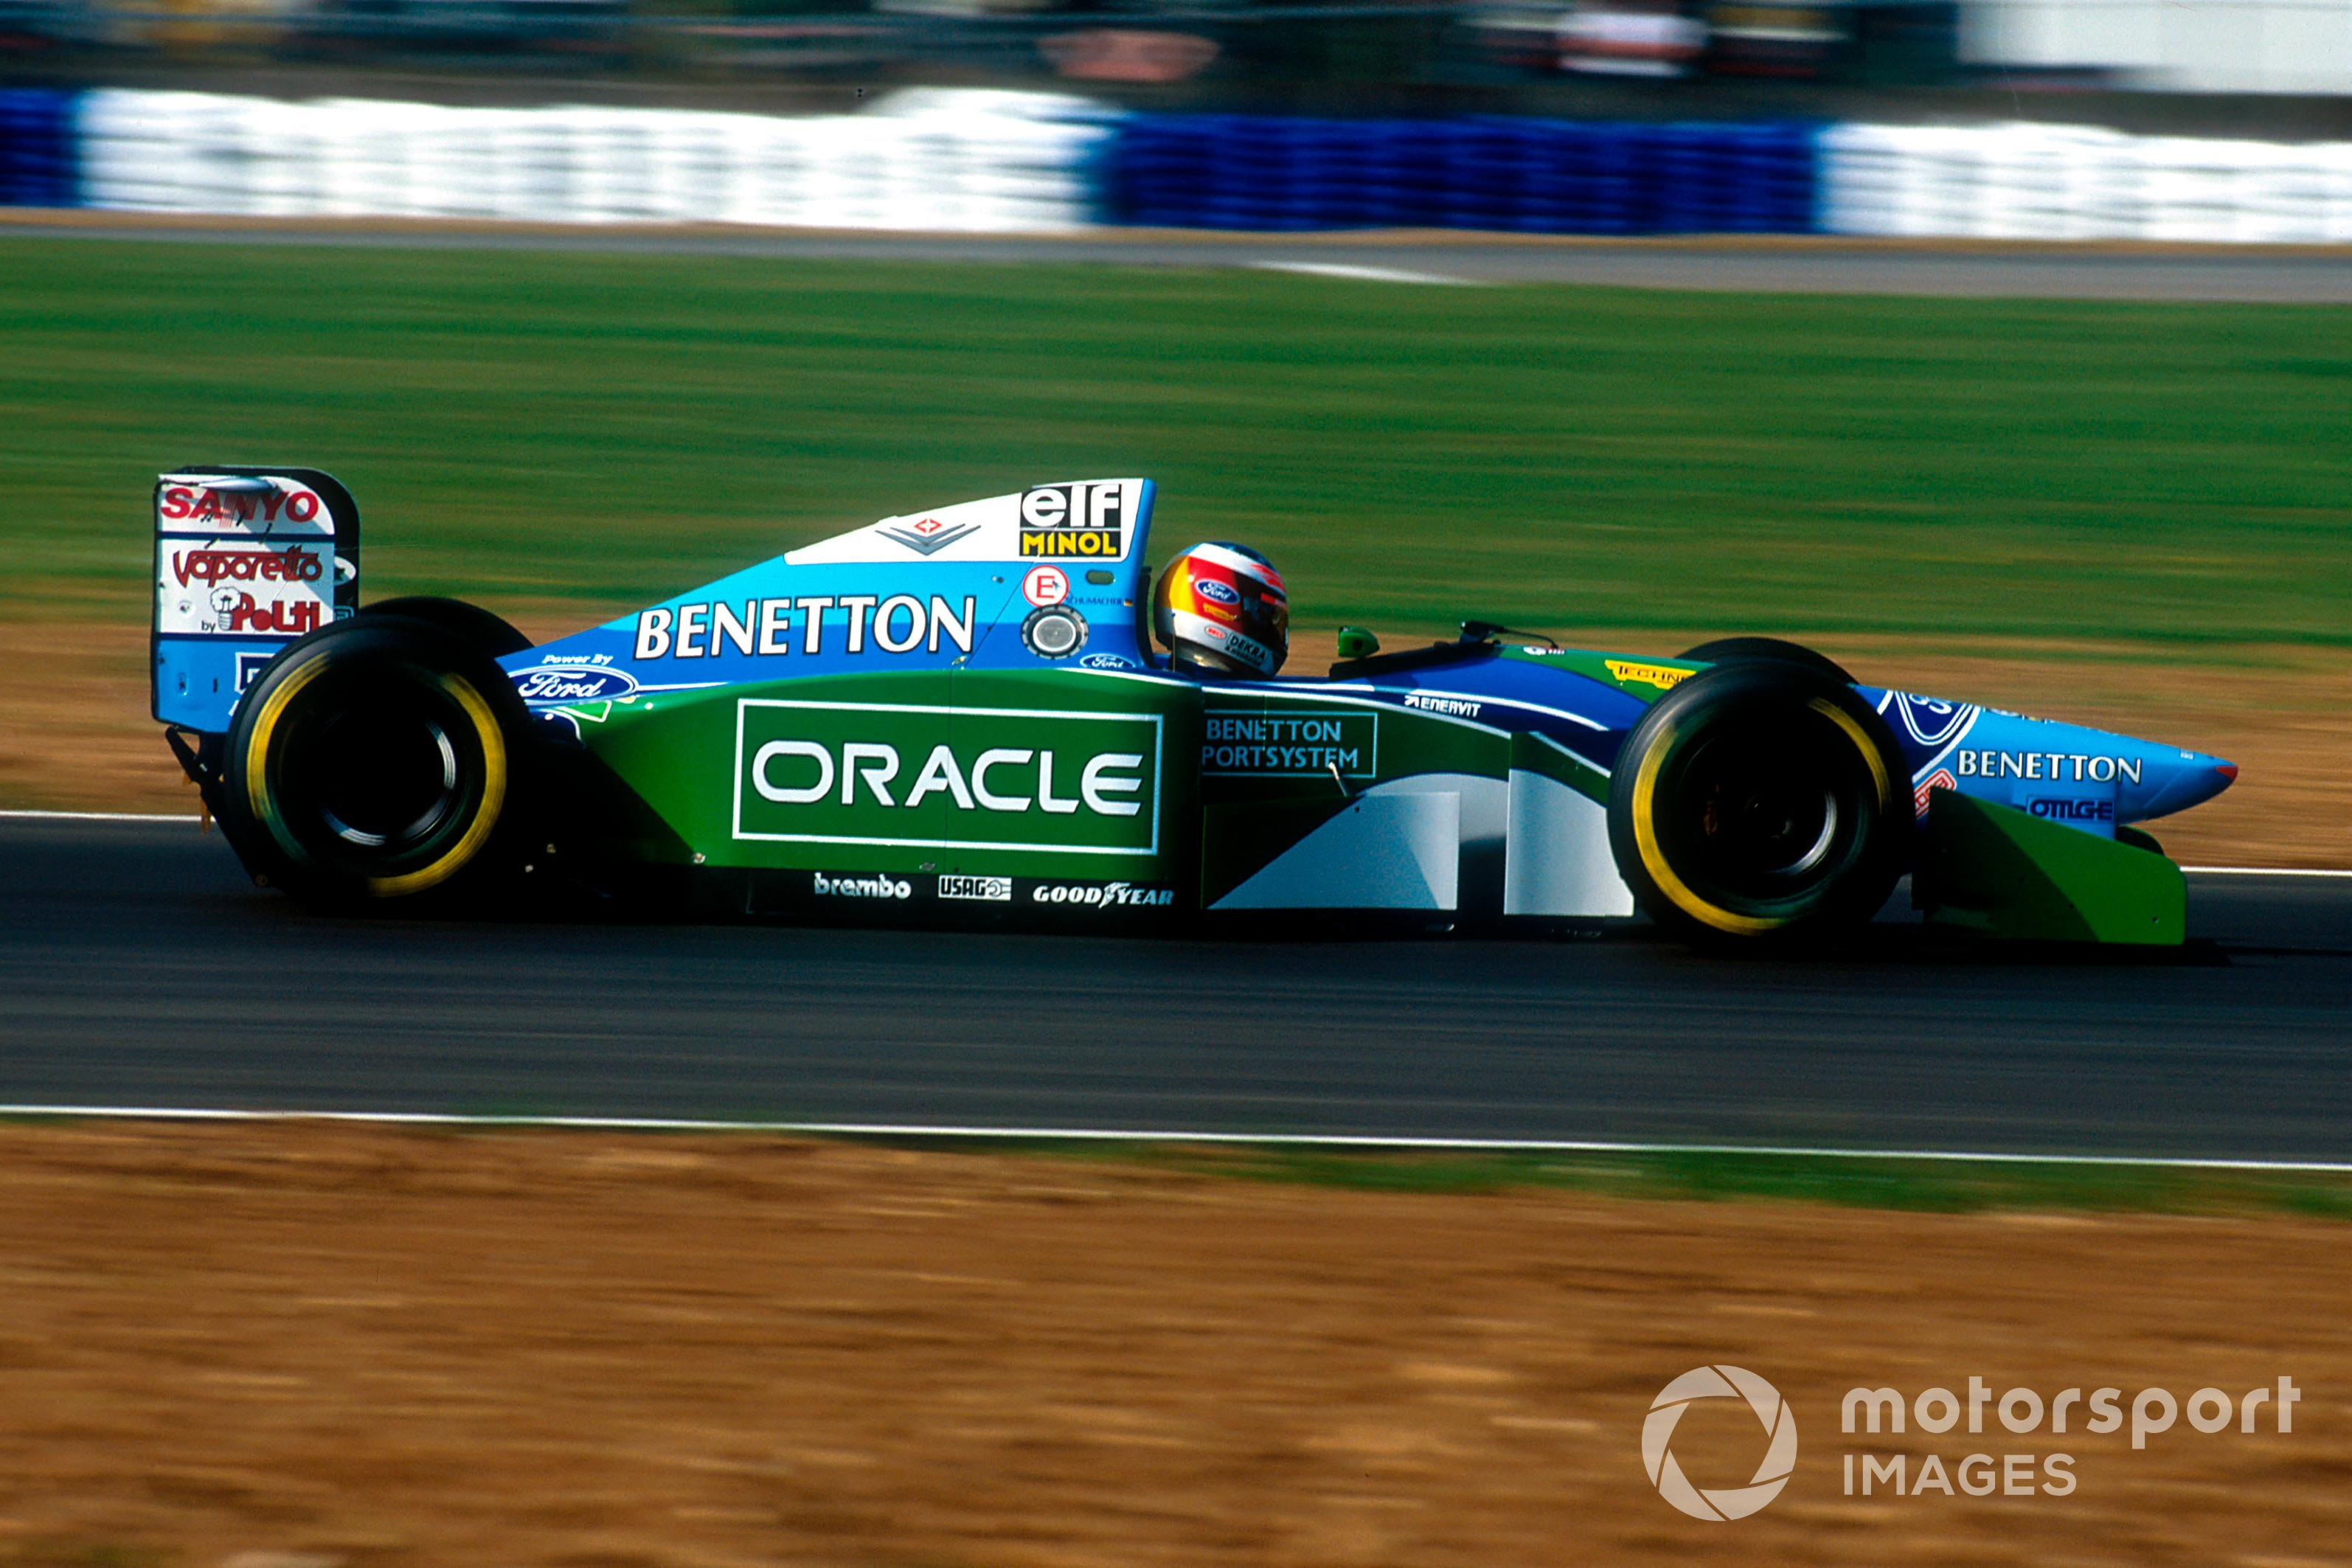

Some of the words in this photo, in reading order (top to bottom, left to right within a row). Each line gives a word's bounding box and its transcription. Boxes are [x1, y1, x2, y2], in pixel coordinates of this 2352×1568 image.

[161, 487, 319, 524] SANYO
[1021, 485, 1120, 528] elf
[1023, 532, 1117, 555] MINOL
[173, 545, 323, 588] Vaporetto
[1203, 581, 1231, 601] Ford
[201, 620, 216, 634] by
[634, 594, 976, 660] BENETTON
[542, 655, 589, 665] Power
[591, 654, 613, 665] By
[1091, 655, 1124, 668] Ford
[518, 672, 606, 698] Ford
[1207, 718, 1342, 742] BENETTON
[1202, 745, 1358, 769] PORTSYSTEM
[1957, 749, 2142, 784] BENETTON
[752, 739, 1144, 816] ORACLE
[814, 873, 912, 899] brembo
[940, 877, 986, 898] USAG
